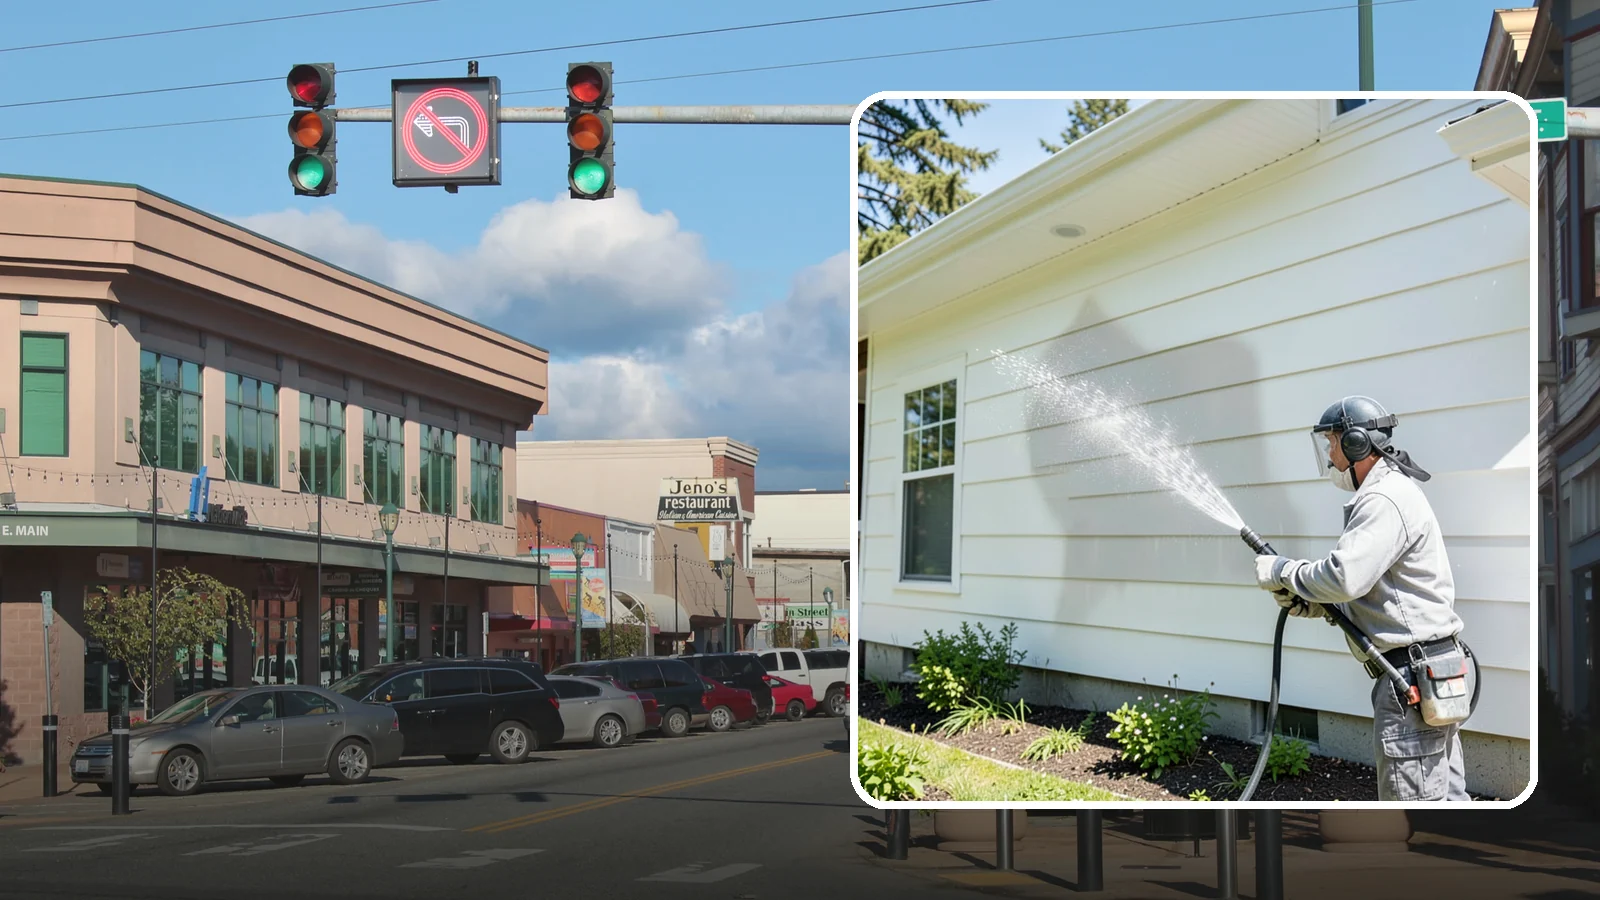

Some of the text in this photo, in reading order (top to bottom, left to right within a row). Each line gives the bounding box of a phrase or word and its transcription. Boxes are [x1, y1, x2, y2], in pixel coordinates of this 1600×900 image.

[669, 480, 727, 494] Jeno's
[665, 496, 731, 509] restaurant
[658, 509, 681, 519] Italian
[686, 509, 714, 519] American
[715, 509, 737, 519] Cuisine
[2, 525, 49, 536] E. MAIN
[797, 607, 828, 616] Street
[790, 619, 823, 627] lass
